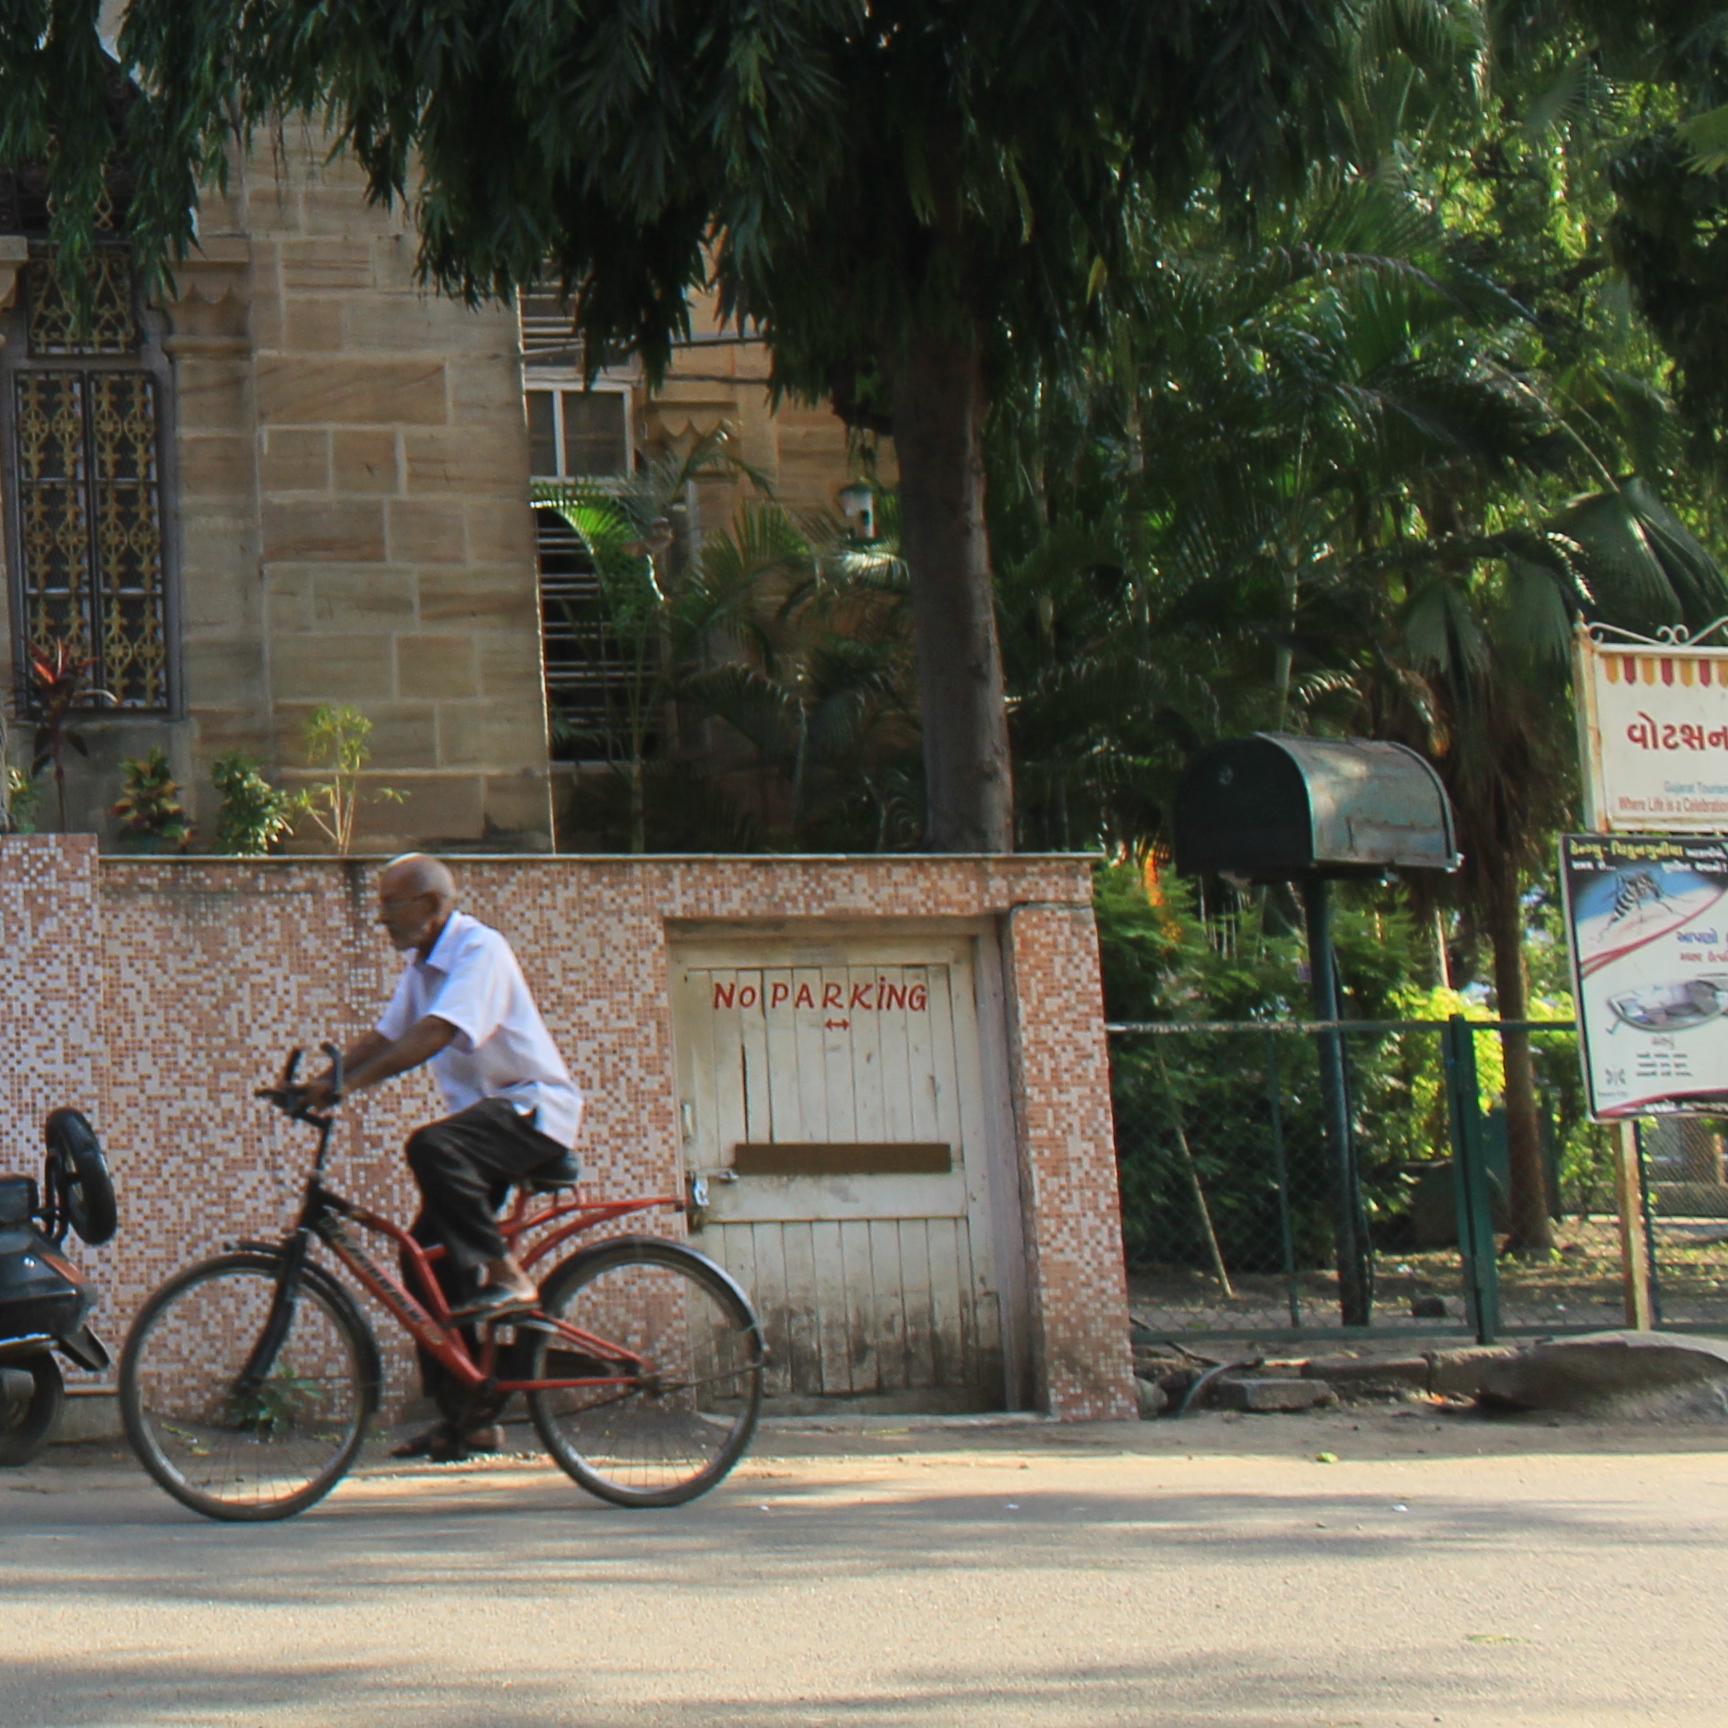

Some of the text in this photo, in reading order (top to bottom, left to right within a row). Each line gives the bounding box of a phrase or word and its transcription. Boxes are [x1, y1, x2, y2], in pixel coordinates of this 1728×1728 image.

[1626, 710, 1728, 750] વોટસન
[1619, 797, 1645, 810] Where
[1648, 797, 1664, 811] Life
[713, 976, 929, 1012] NO PARKING
